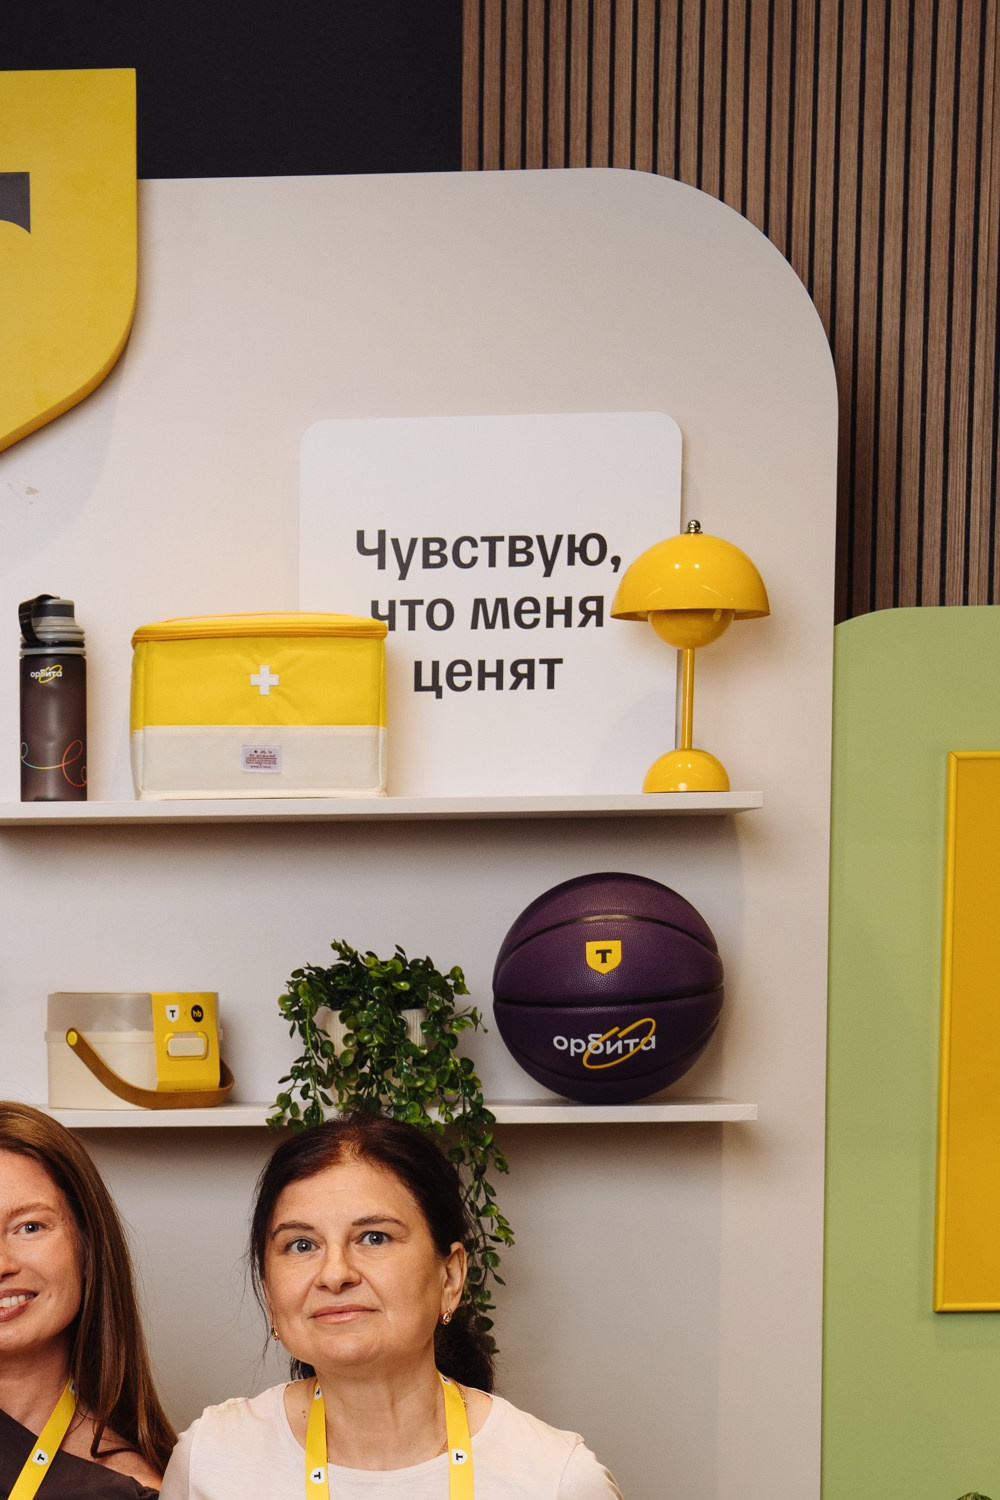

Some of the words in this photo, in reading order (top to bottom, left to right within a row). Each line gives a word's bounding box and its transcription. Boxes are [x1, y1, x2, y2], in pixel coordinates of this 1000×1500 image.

[355, 528, 622, 581] Чувствую,
[370, 598, 455, 632] что
[470, 595, 605, 630] меня
[30, 668, 63, 680] орбита
[413, 657, 564, 699] ценят
[595, 948, 612, 964] Т
[552, 1033, 656, 1057] орбита
